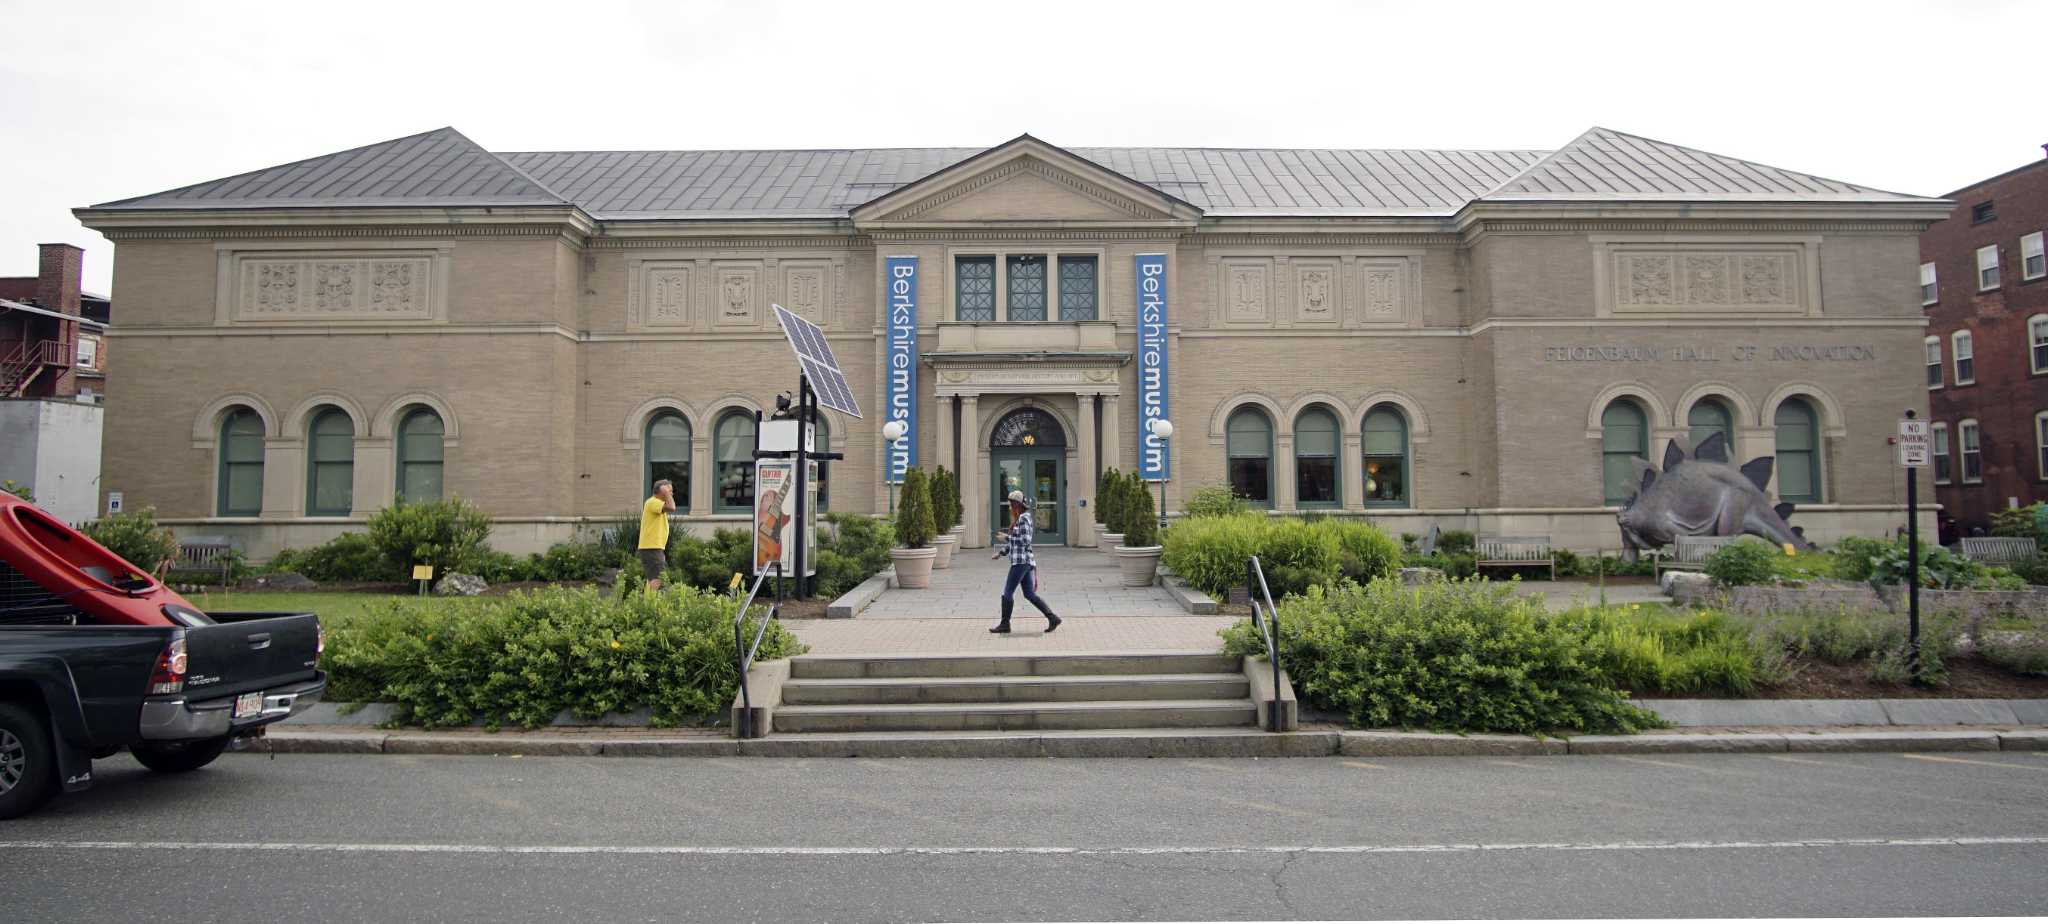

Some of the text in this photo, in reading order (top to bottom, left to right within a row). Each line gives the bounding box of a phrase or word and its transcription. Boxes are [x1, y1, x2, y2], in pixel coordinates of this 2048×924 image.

[1545, 346, 1875, 361] FEIGENBAUM HALL OF INNOVATION
[1908, 423, 1920, 433] NO
[1901, 434, 1928, 443] PARKING
